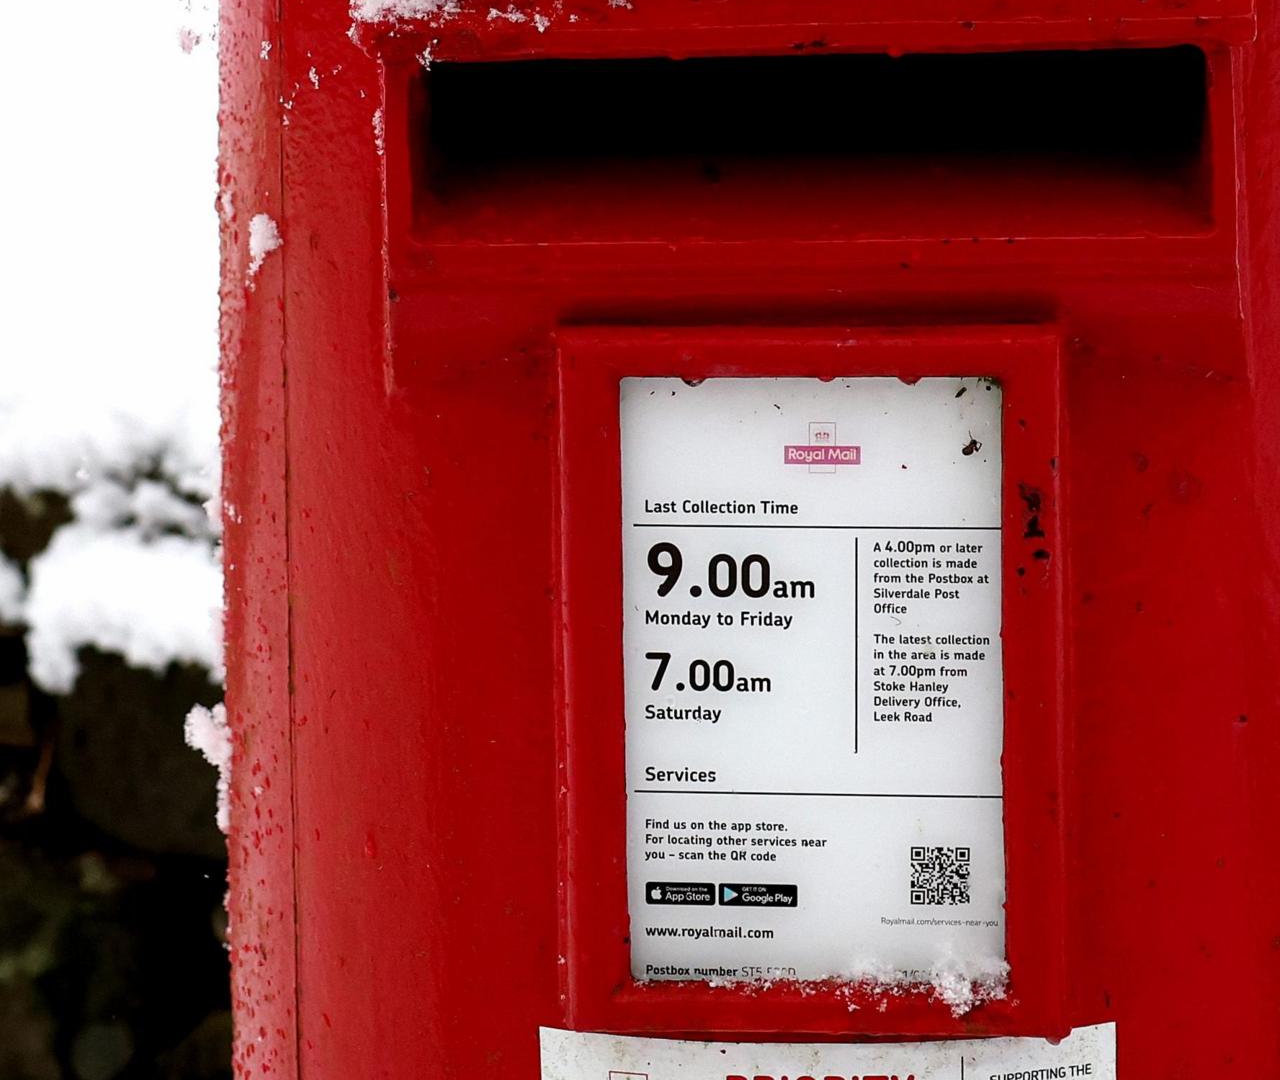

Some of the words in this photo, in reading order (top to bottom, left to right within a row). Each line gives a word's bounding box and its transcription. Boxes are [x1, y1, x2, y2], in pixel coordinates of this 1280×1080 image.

[789, 449, 824, 462] Royal
[829, 449, 856, 460] Mail
[645, 500, 677, 513] Last
[683, 500, 755, 513] Collection
[761, 501, 798, 514] Time
[874, 543, 881, 552] A
[885, 541, 934, 555] 4.00pm
[956, 543, 983, 553] later
[874, 558, 927, 568] collection
[933, 558, 941, 568] is
[946, 559, 977, 568] made
[648, 542, 814, 598] 9.00am
[874, 573, 901, 583] from
[906, 574, 923, 583] the
[929, 574, 973, 583] Postbox
[977, 575, 989, 583] at
[874, 588, 930, 598] Silverdale
[935, 589, 959, 598] Post
[874, 604, 906, 613] Office
[646, 610, 710, 628] Monday
[717, 613, 733, 625] to
[741, 612, 792, 629] Friday
[874, 634, 894, 644] The
[900, 635, 931, 644] latest
[936, 635, 989, 645] collection
[874, 649, 883, 659] in
[889, 650, 906, 659] the
[941, 650, 949, 660] is
[954, 651, 985, 660] made
[645, 652, 770, 692] 7.00am
[874, 667, 885, 676] at
[889, 665, 935, 678] 7.00pm
[940, 666, 967, 676] from
[874, 681, 905, 691] Stoke
[910, 682, 948, 694] Hanley
[874, 696, 920, 708] Delivery
[925, 697, 960, 708] Office,
[645, 705, 721, 723] Saturday
[874, 712, 900, 721] Leek
[905, 712, 932, 722] Road
[646, 767, 715, 782] Services
[646, 819, 669, 829] Find
[709, 821, 726, 830] the
[731, 823, 751, 832] app
[756, 822, 787, 831] store.
[646, 834, 663, 844] For
[668, 835, 712, 847] locating
[717, 836, 747, 845] other
[645, 852, 665, 861] you
[708, 851, 726, 860] the
[751, 852, 776, 861] code
[665, 892, 684, 902] App
[686, 892, 710, 901] Store
[742, 893, 773, 904] Google
[775, 894, 792, 904] Play
[646, 926, 773, 939] www.royalmail.com
[646, 965, 690, 975] Postbox
[694, 967, 738, 976] number
[1069, 1063, 1092, 1077] THE
